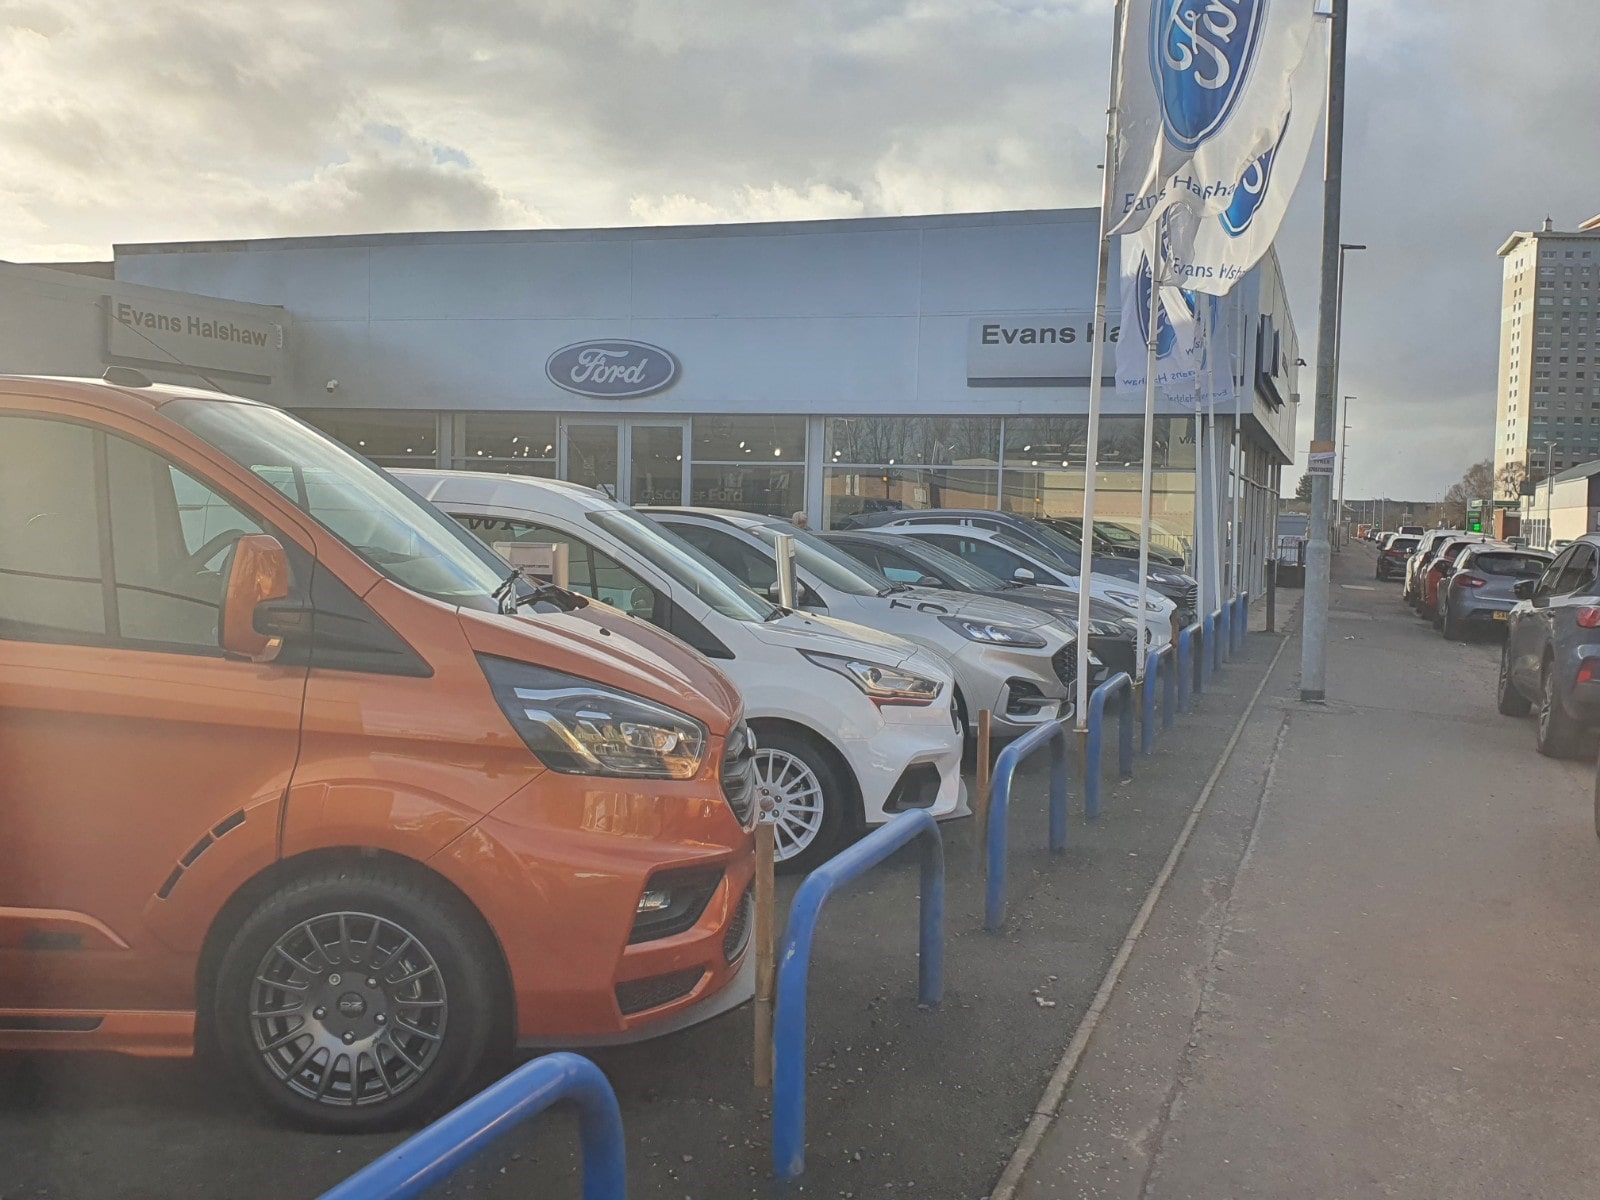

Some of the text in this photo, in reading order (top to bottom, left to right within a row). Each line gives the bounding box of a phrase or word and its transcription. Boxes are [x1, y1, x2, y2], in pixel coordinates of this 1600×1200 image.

[1123, 187, 1166, 214] Eans
[117, 302, 268, 347] Evans Halshaw
[981, 324, 1076, 345] Evans
[570, 348, 649, 384] Ford
